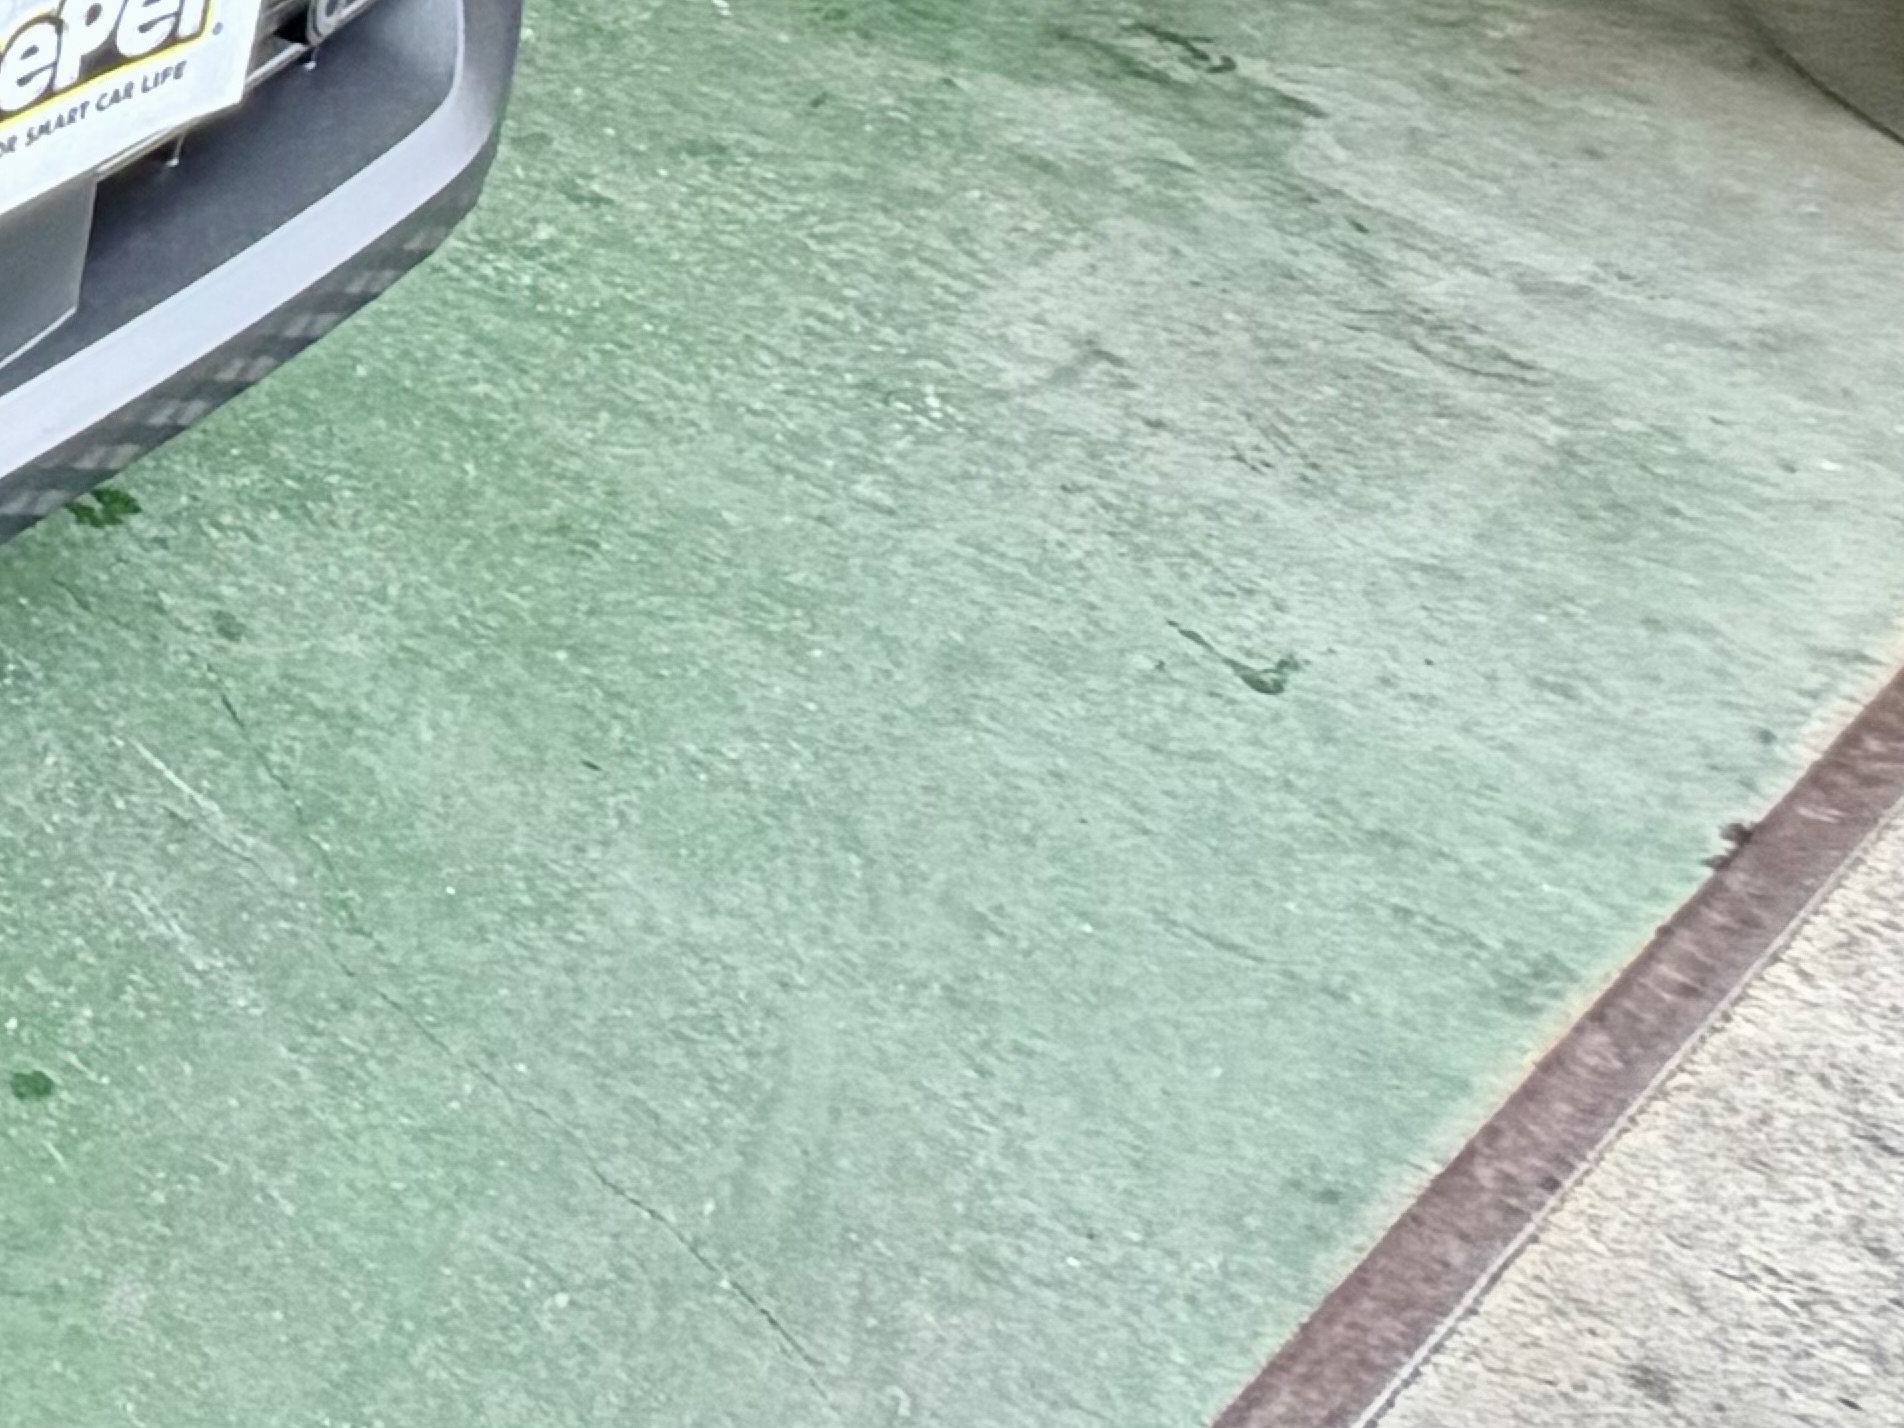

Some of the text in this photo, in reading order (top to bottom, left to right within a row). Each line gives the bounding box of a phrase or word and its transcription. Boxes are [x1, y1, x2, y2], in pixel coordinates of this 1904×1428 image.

[25, 100, 90, 147] SMART
[96, 80, 134, 111] CAR
[141, 60, 187, 94] LIFE
